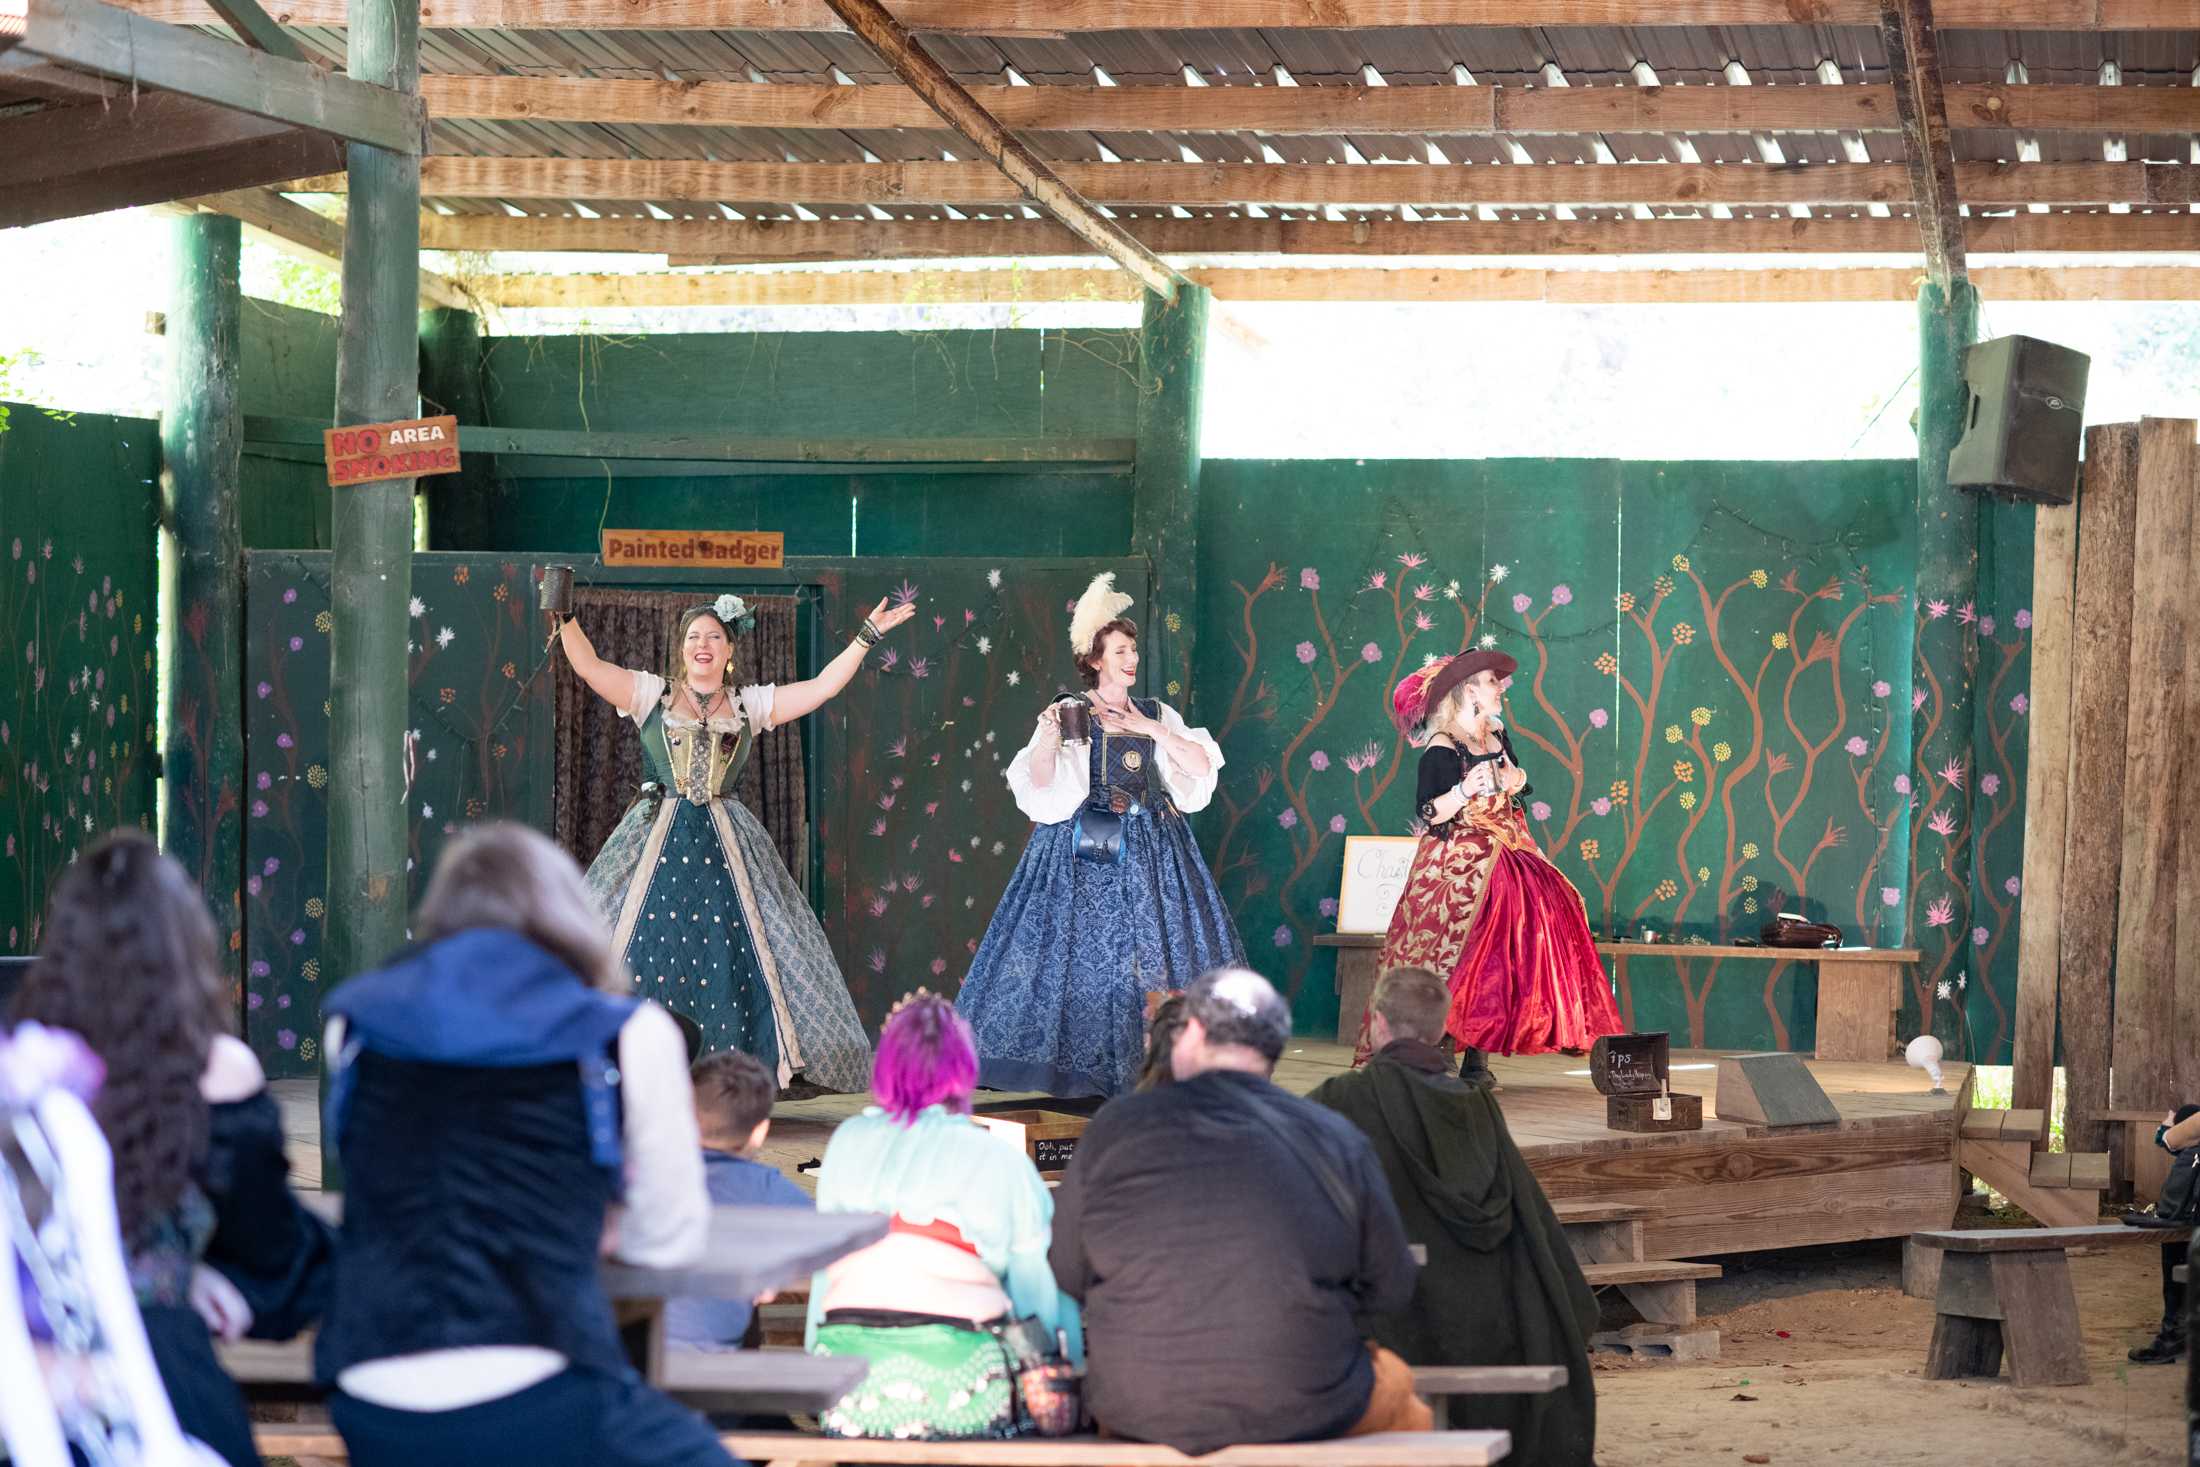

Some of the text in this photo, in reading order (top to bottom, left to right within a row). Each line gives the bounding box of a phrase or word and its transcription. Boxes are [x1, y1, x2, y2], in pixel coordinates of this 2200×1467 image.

[332, 425, 445, 456] NO AREA
[334, 447, 455, 481] SMOKING
[608, 538, 780, 565] Painted Badger
[1058, 1143, 1073, 1153] put
